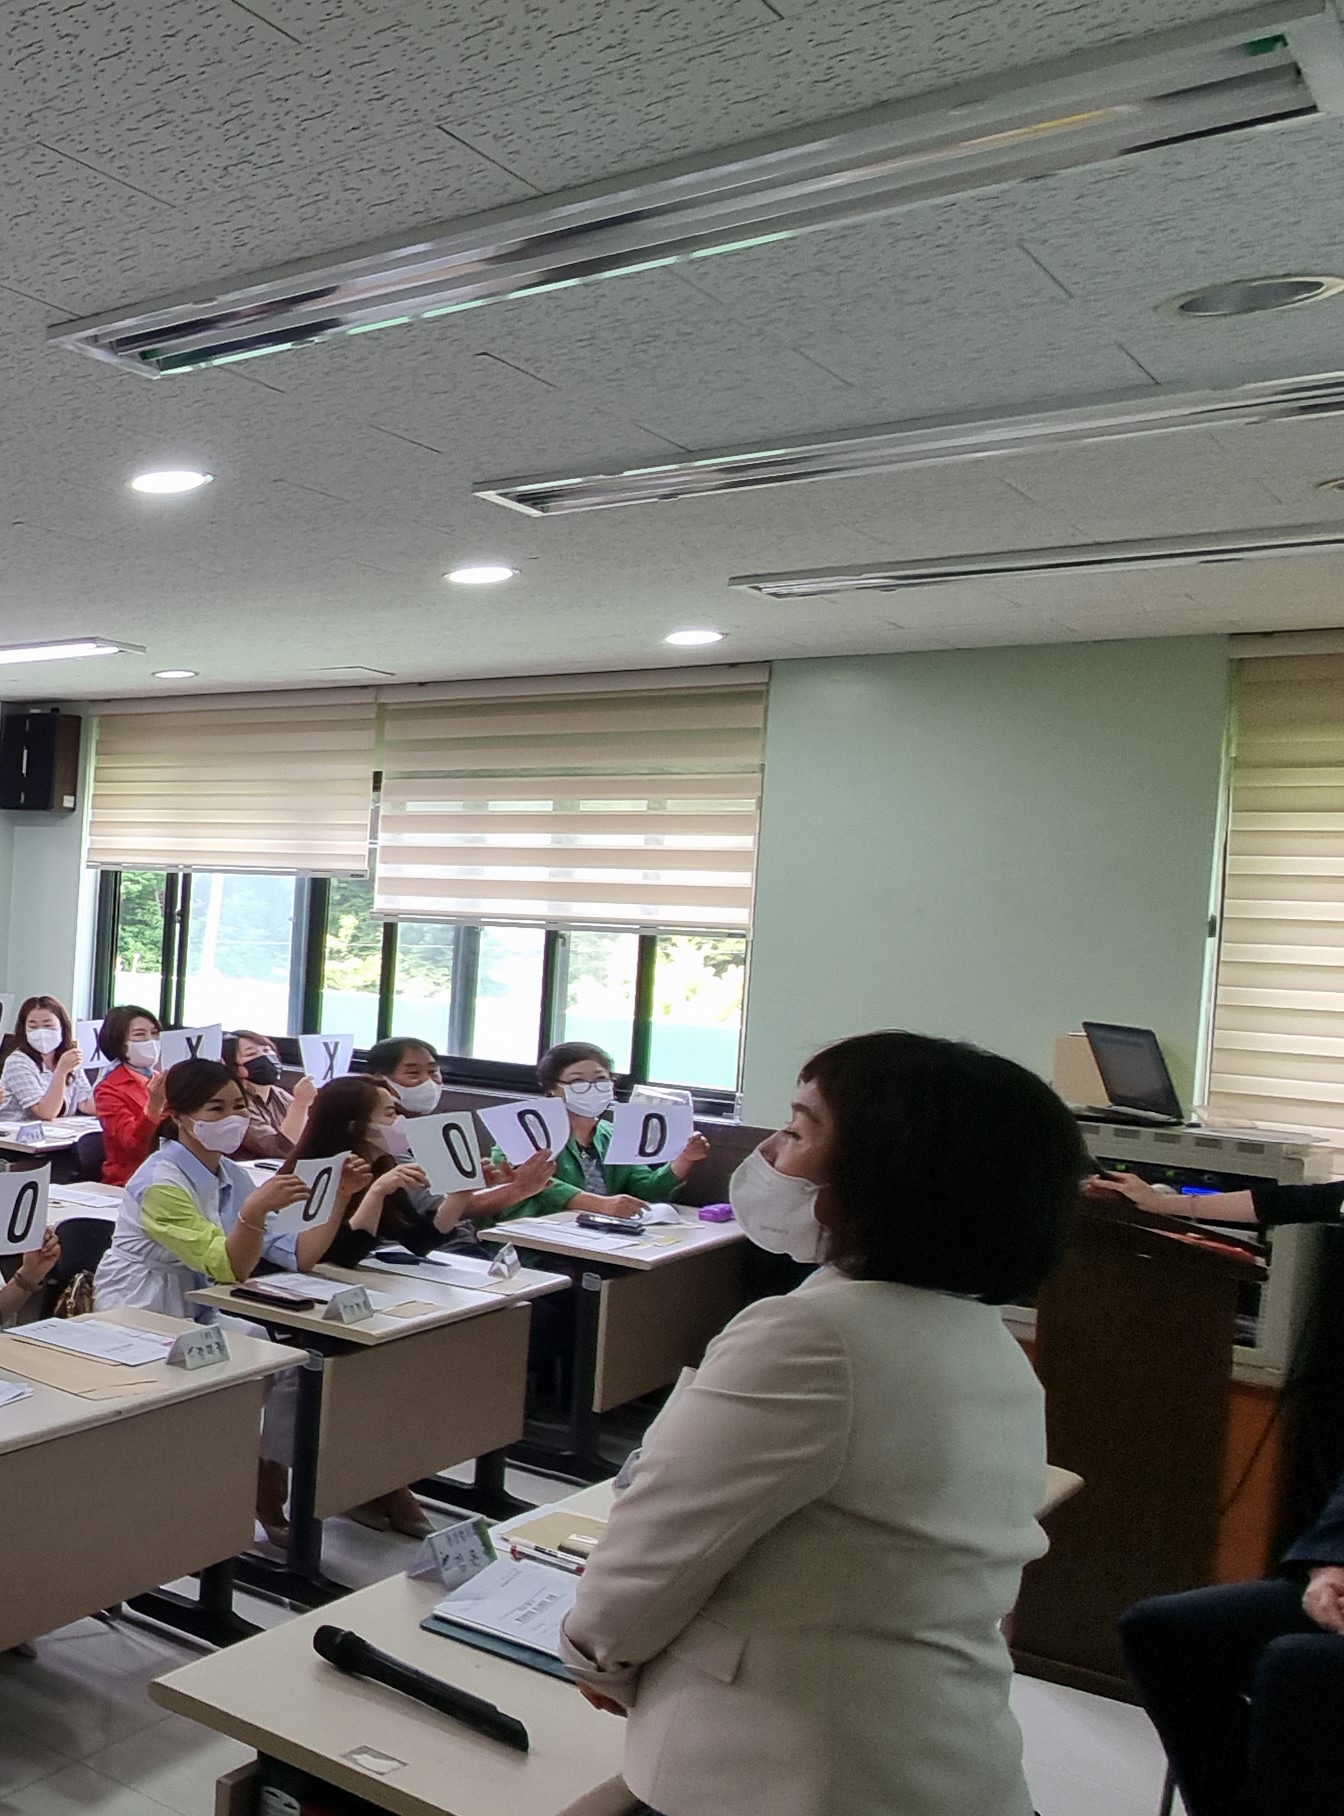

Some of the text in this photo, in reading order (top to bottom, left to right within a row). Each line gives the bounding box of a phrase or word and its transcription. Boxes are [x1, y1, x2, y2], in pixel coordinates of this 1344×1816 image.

[322, 1041, 340, 1080] X
[442, 1122, 478, 1179] O
[517, 1108, 551, 1152] O
[639, 1112, 668, 1158] O
[7, 1180, 39, 1244] O
[303, 1166, 332, 1222] O
